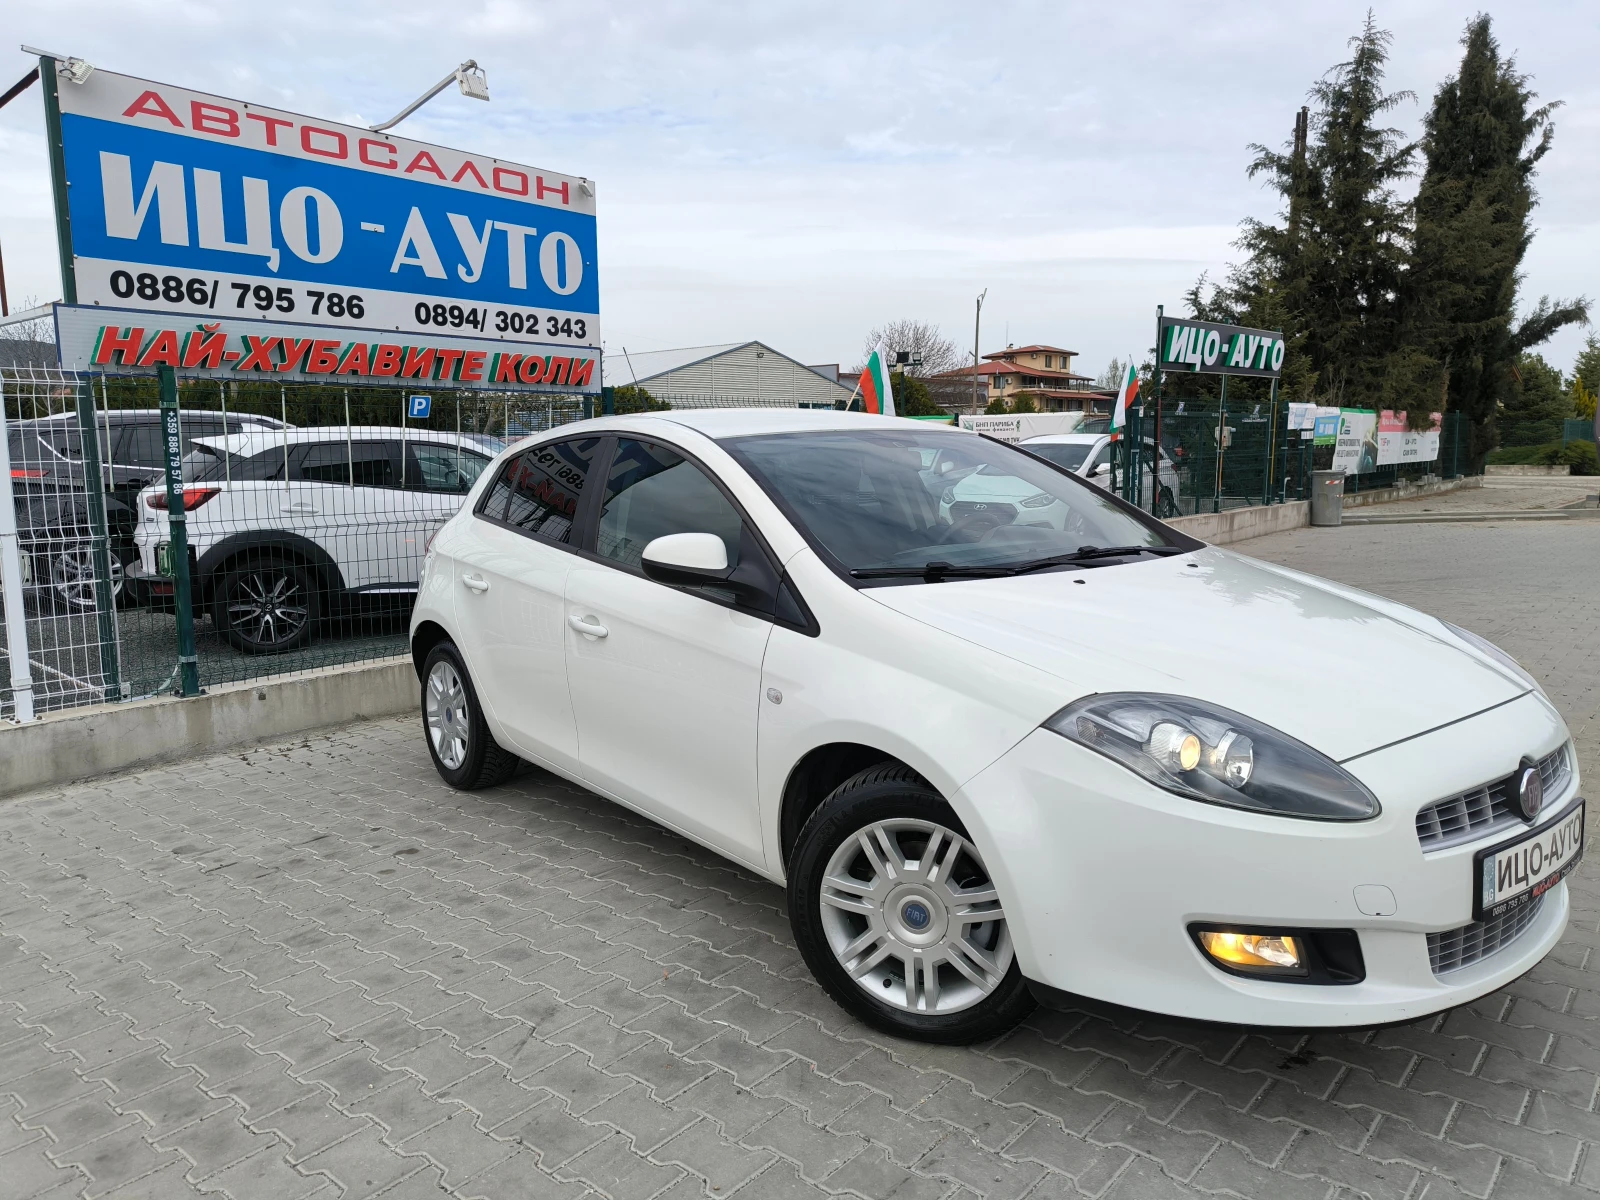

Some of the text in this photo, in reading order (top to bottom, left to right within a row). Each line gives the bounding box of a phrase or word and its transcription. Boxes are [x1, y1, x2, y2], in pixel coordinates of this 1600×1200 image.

[122, 90, 570, 205] АВТОСАЛОН
[110, 270, 365, 320] 0886/ 795 786
[414, 302, 587, 340] 0894/ 302 343
[91, 322, 596, 387] НАЙ-ХУБАВИТЕ КОЛИ
[1163, 325, 1285, 372] ИЦО-АУТО
[413, 398, 426, 415] P
[167, 411, 183, 495] +359 886 79 57 86
[1497, 814, 1582, 893] ИЦО-АУТО
[906, 907, 926, 923] FIAT
